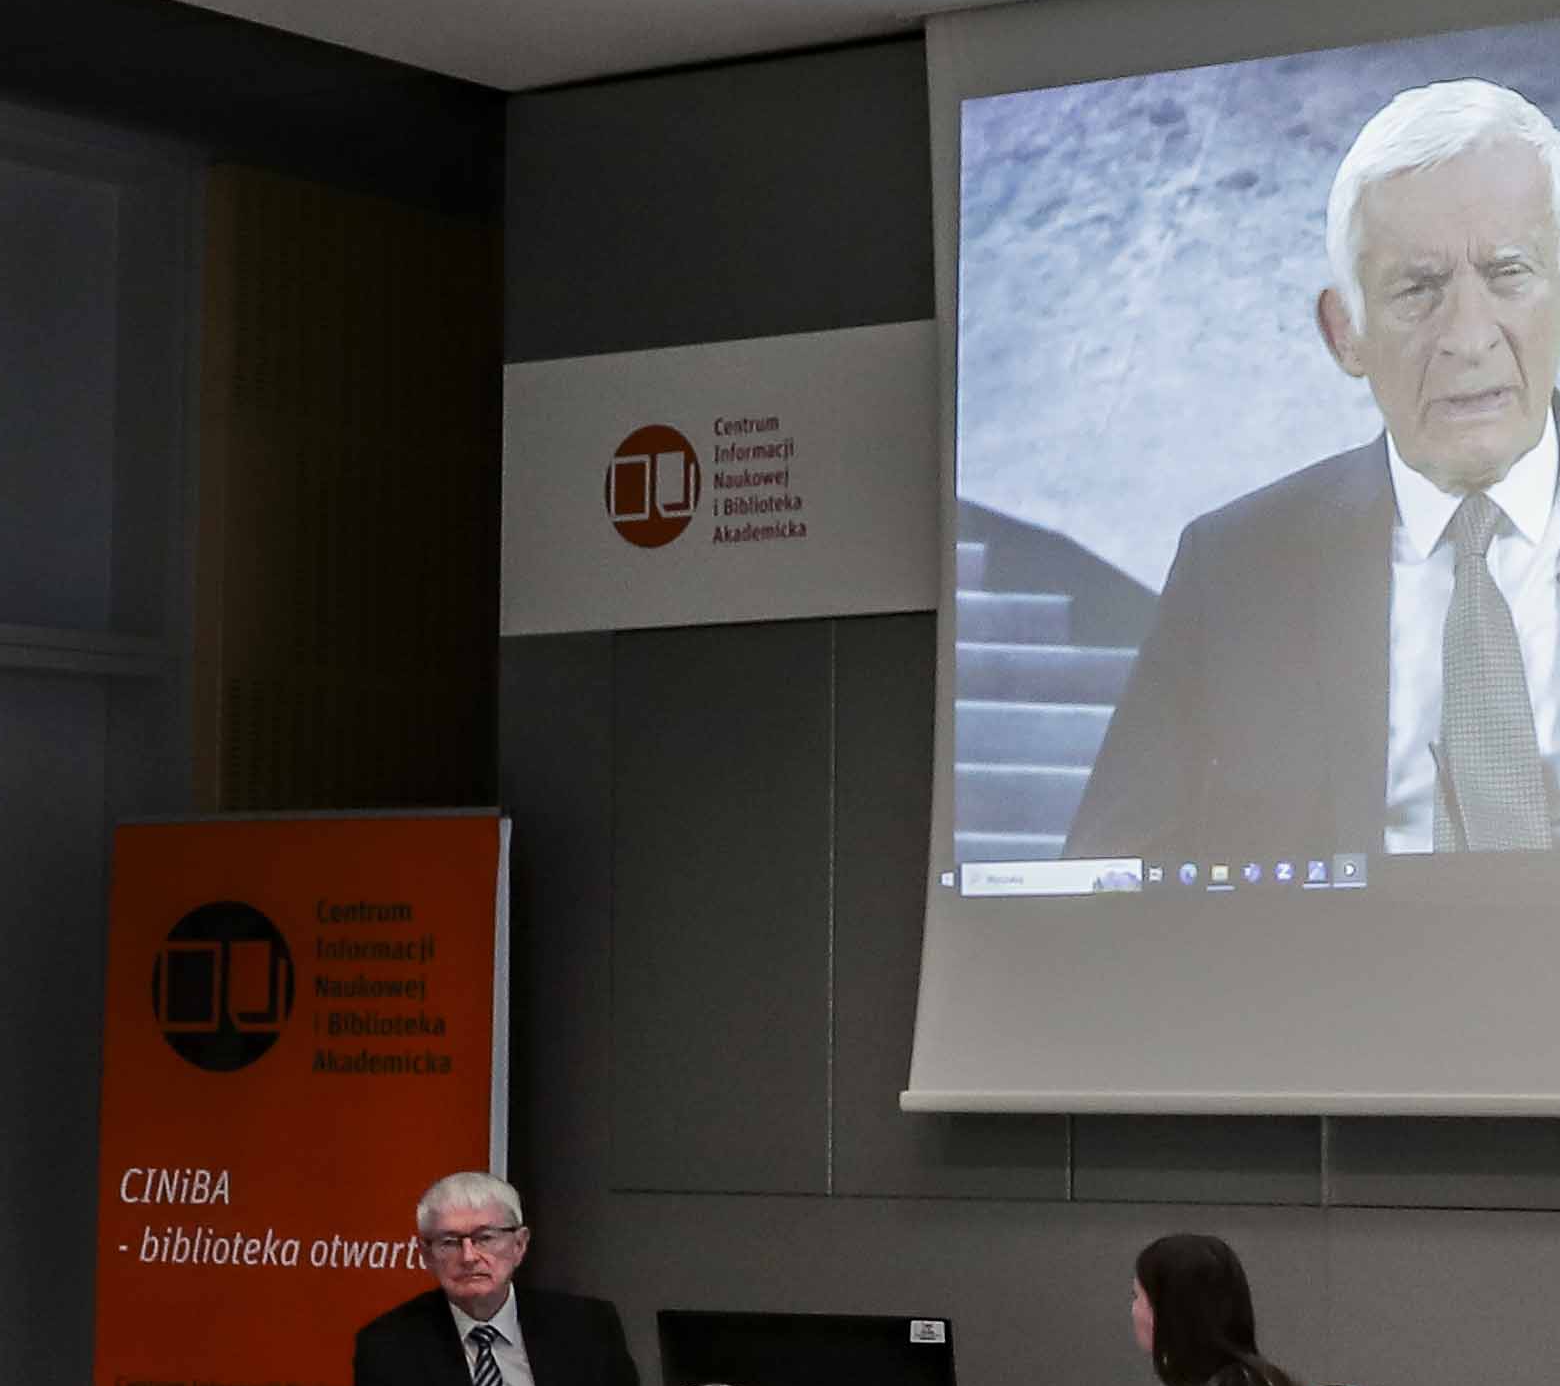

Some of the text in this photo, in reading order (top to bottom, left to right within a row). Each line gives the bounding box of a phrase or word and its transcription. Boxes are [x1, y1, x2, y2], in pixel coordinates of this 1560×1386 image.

[714, 417, 779, 436] Centrum
[715, 438, 794, 464] Informacji
[724, 494, 802, 515] Biblioteka
[713, 521, 807, 544] Akademicka
[316, 899, 414, 924] Centrum
[120, 1168, 231, 1204] CINiBA
[140, 1226, 301, 1266] biblioteka
[311, 1235, 427, 1269] otwart
